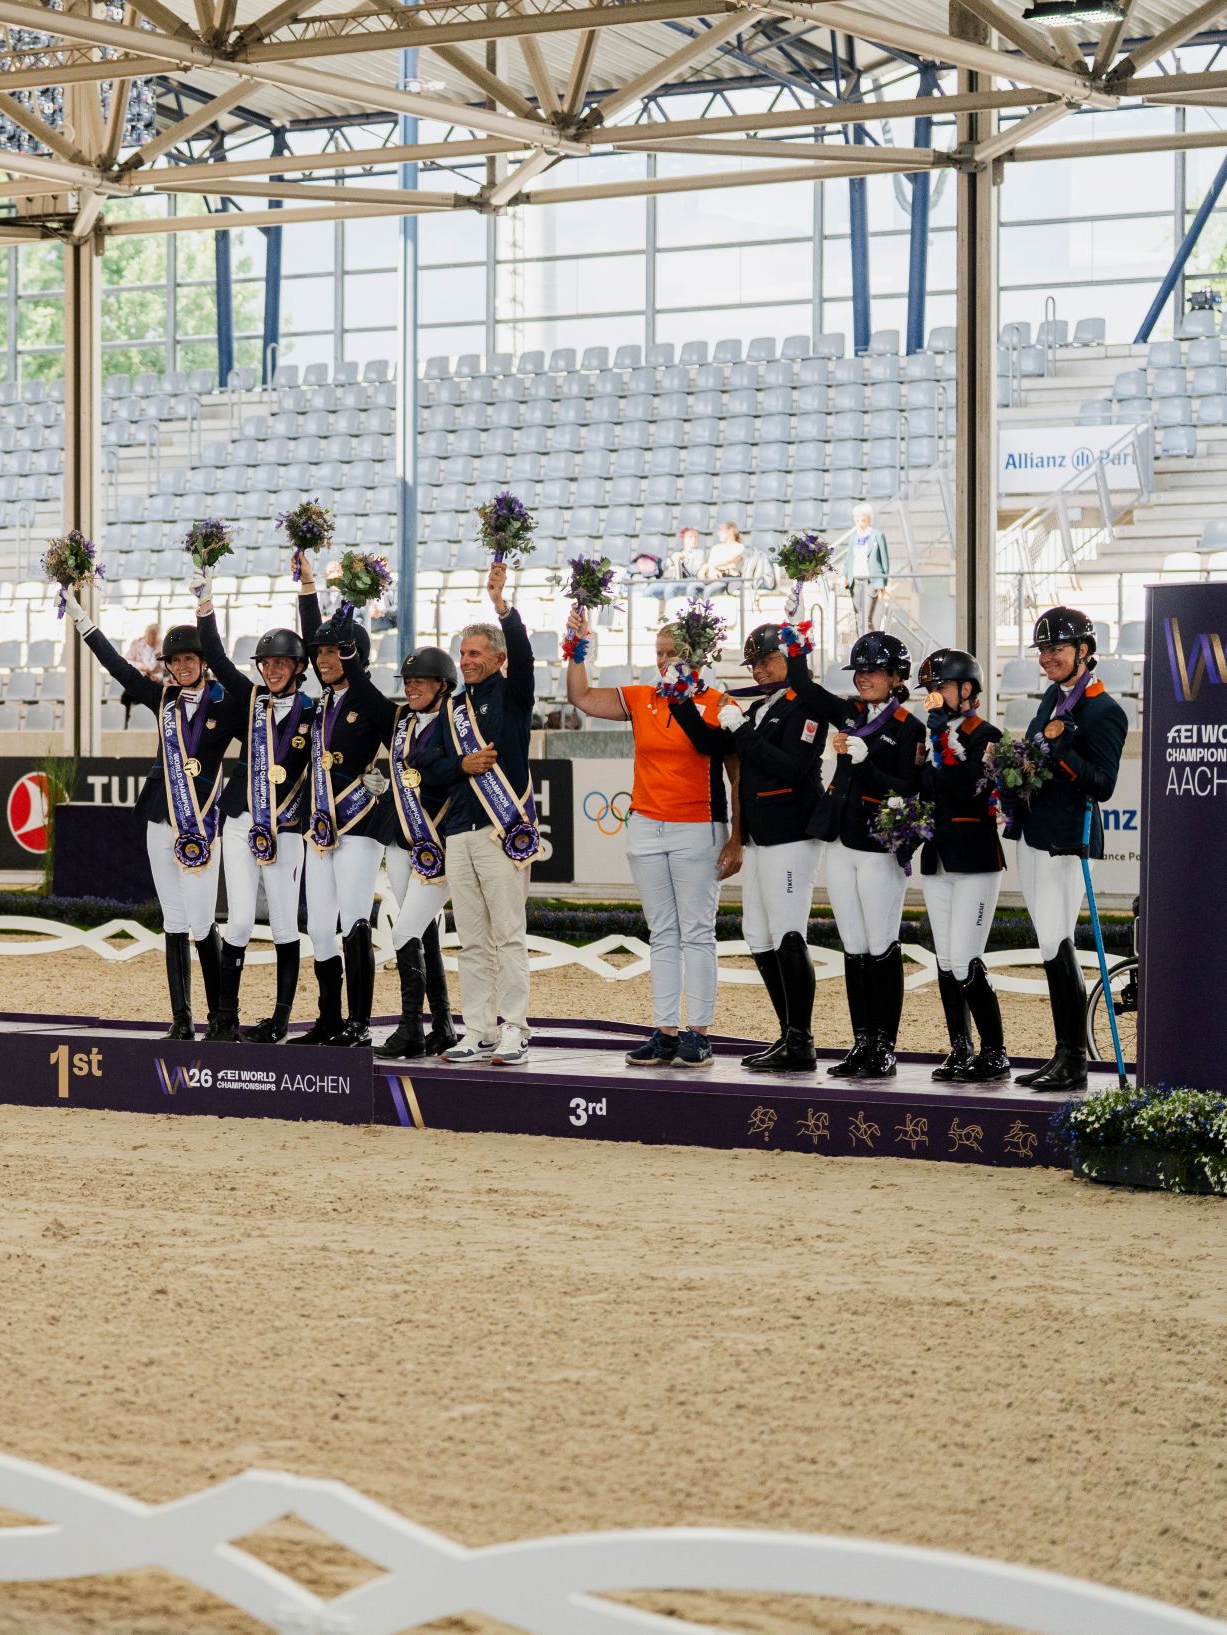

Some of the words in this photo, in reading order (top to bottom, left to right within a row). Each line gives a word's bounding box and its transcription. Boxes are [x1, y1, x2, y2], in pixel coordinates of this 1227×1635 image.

[1004, 452, 1067, 470] Allianz
[174, 753, 183, 779] WORLD
[259, 745, 267, 772] WORLD
[1166, 747, 1227, 762] CHAMPION
[259, 772, 267, 809] CHAMPION
[484, 771, 510, 808] CHAMPION
[1165, 766, 1227, 796] AACH
[178, 779, 192, 817] CHAMPION
[403, 787, 422, 825] CHAMPION
[482, 779, 493, 796] PARA
[490, 793, 512, 824] DRESSAGE
[49, 1044, 103, 1099] 1st
[217, 1080, 276, 1092] CHAMPIONSHIPS
[240, 1071, 276, 1083] WORLD
[281, 1074, 350, 1095] AACHEN
[569, 1097, 607, 1127] 3rd
